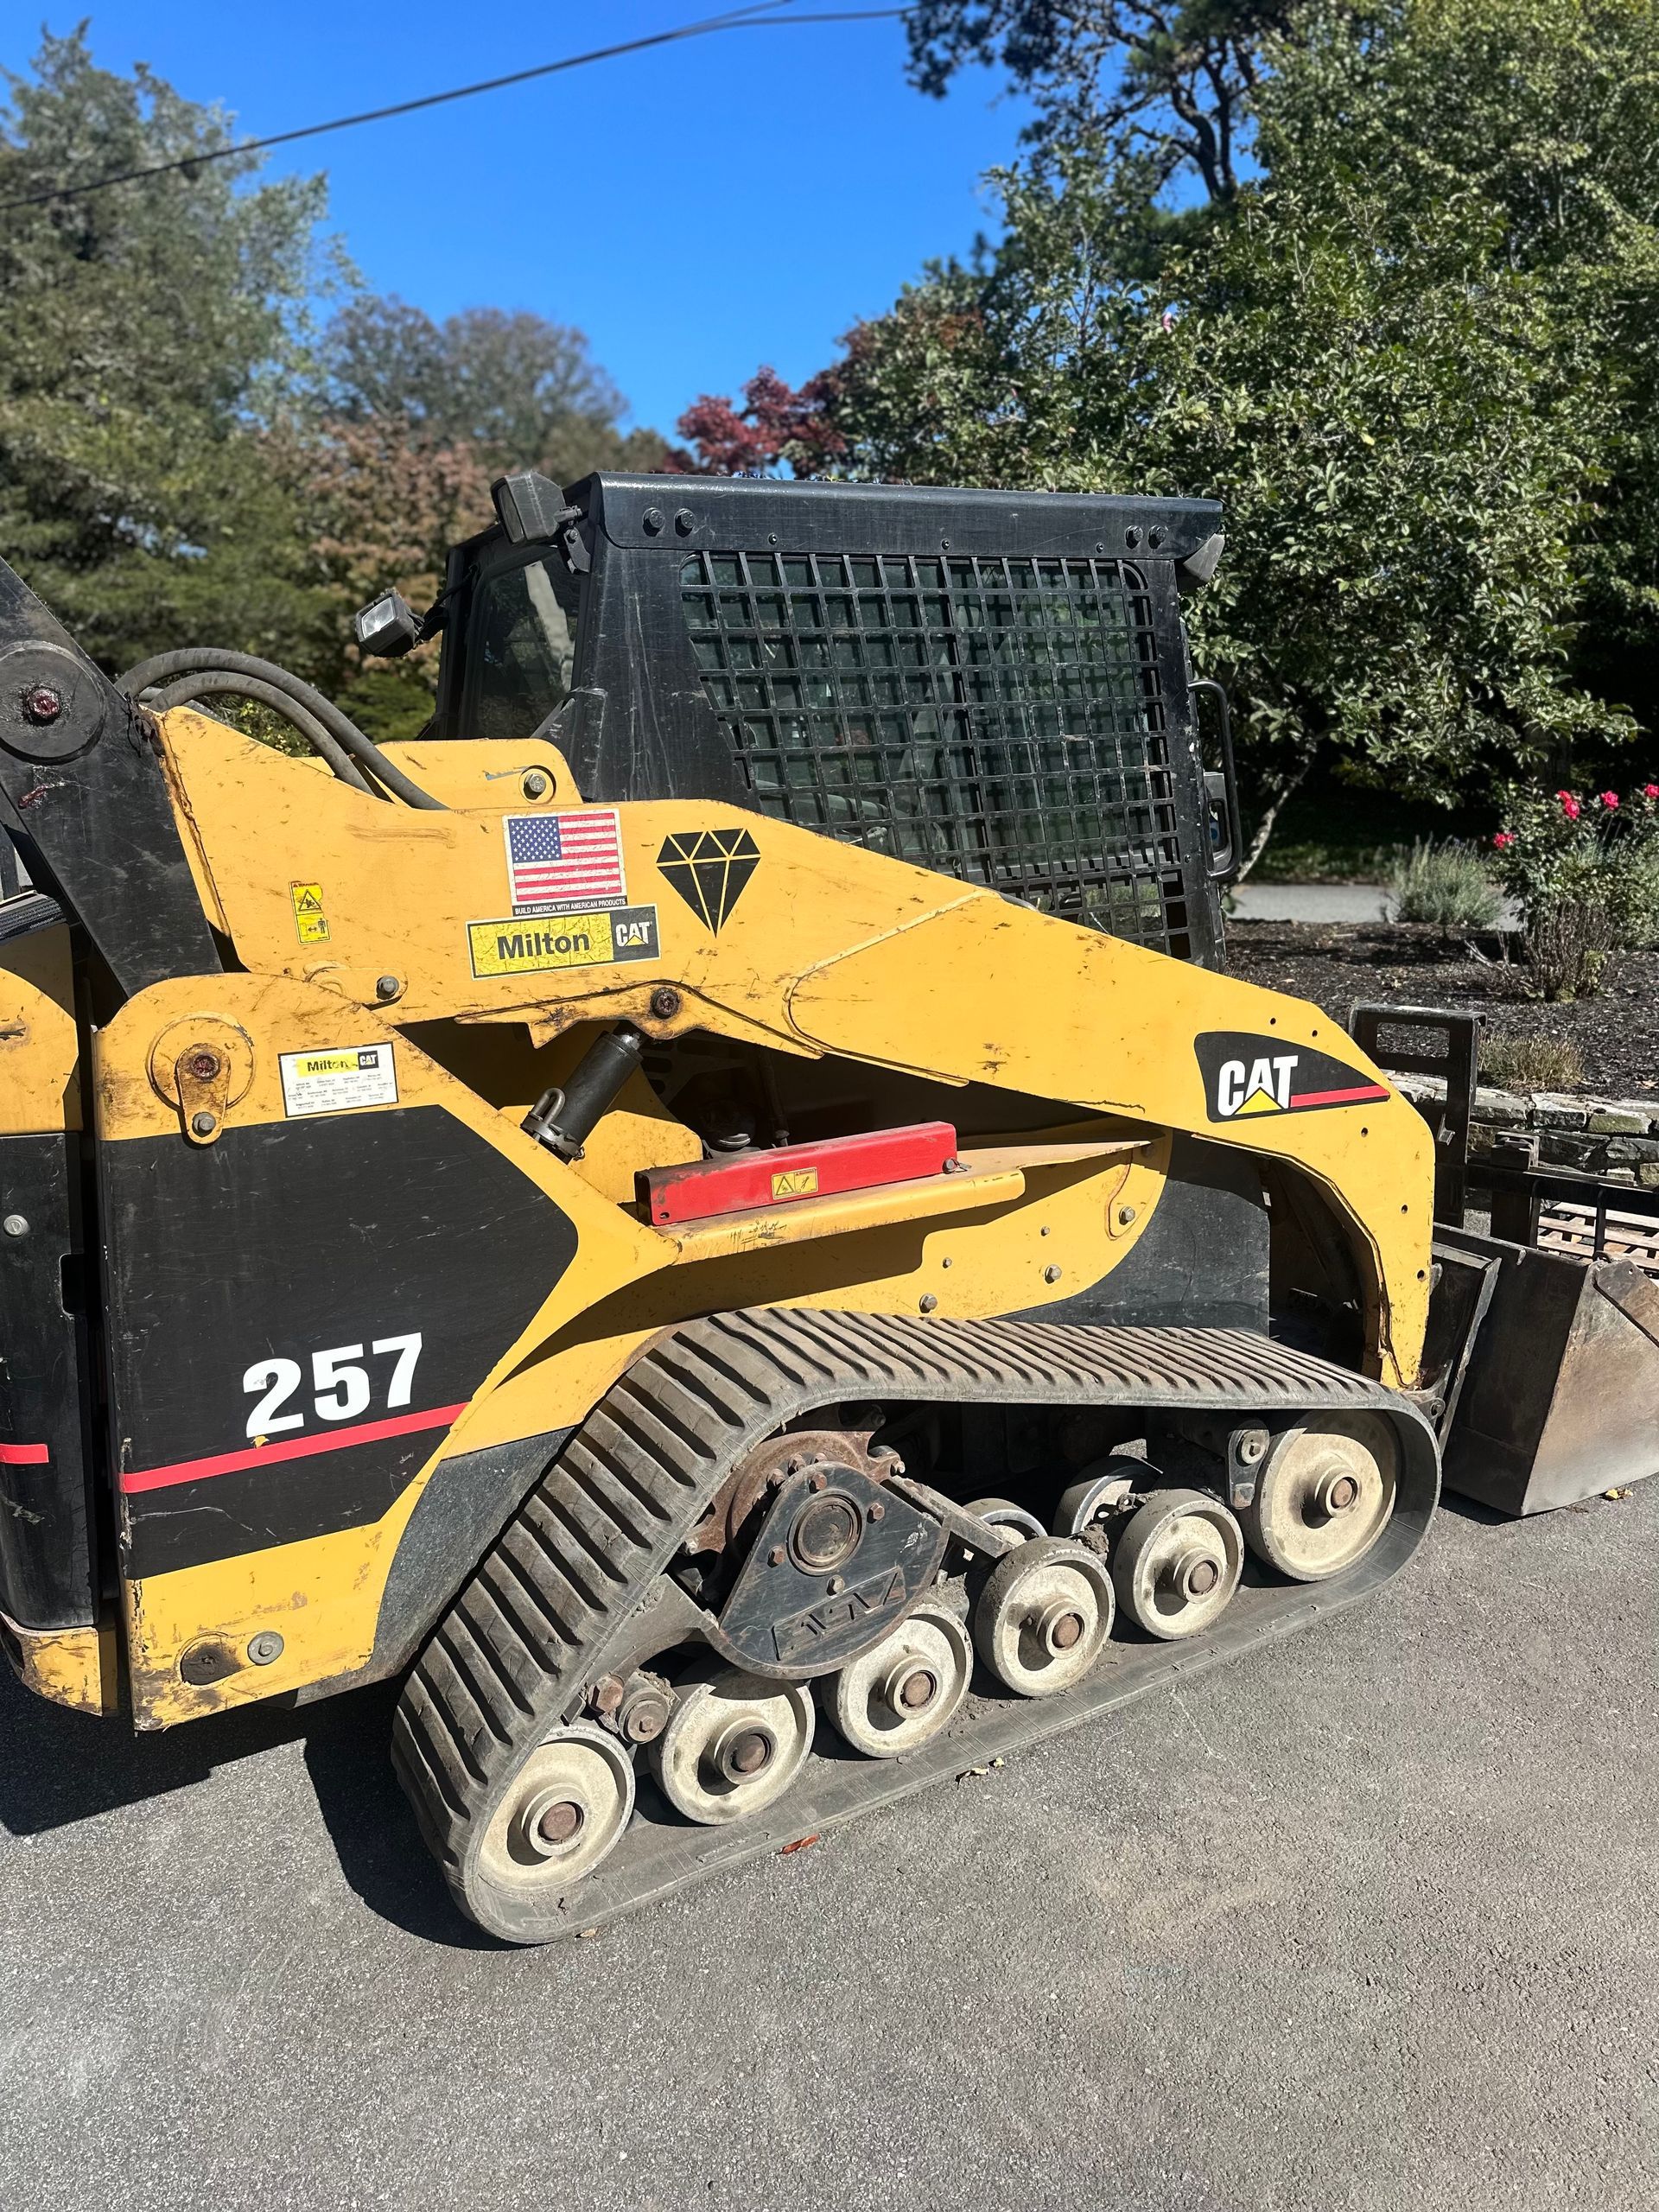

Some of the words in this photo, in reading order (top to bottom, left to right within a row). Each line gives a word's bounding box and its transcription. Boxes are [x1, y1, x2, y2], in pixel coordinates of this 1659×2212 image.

[532, 905, 556, 913] AMERICA
[556, 903, 570, 912] WITH
[570, 900, 597, 910] AMERICAN
[598, 898, 626, 907] PRODUCTS
[497, 932, 590, 960] Milton
[615, 922, 651, 947] CAT
[359, 1054, 378, 1066] CAT
[1217, 1055, 1299, 1116] CAT
[243, 1332, 423, 1439] 257
